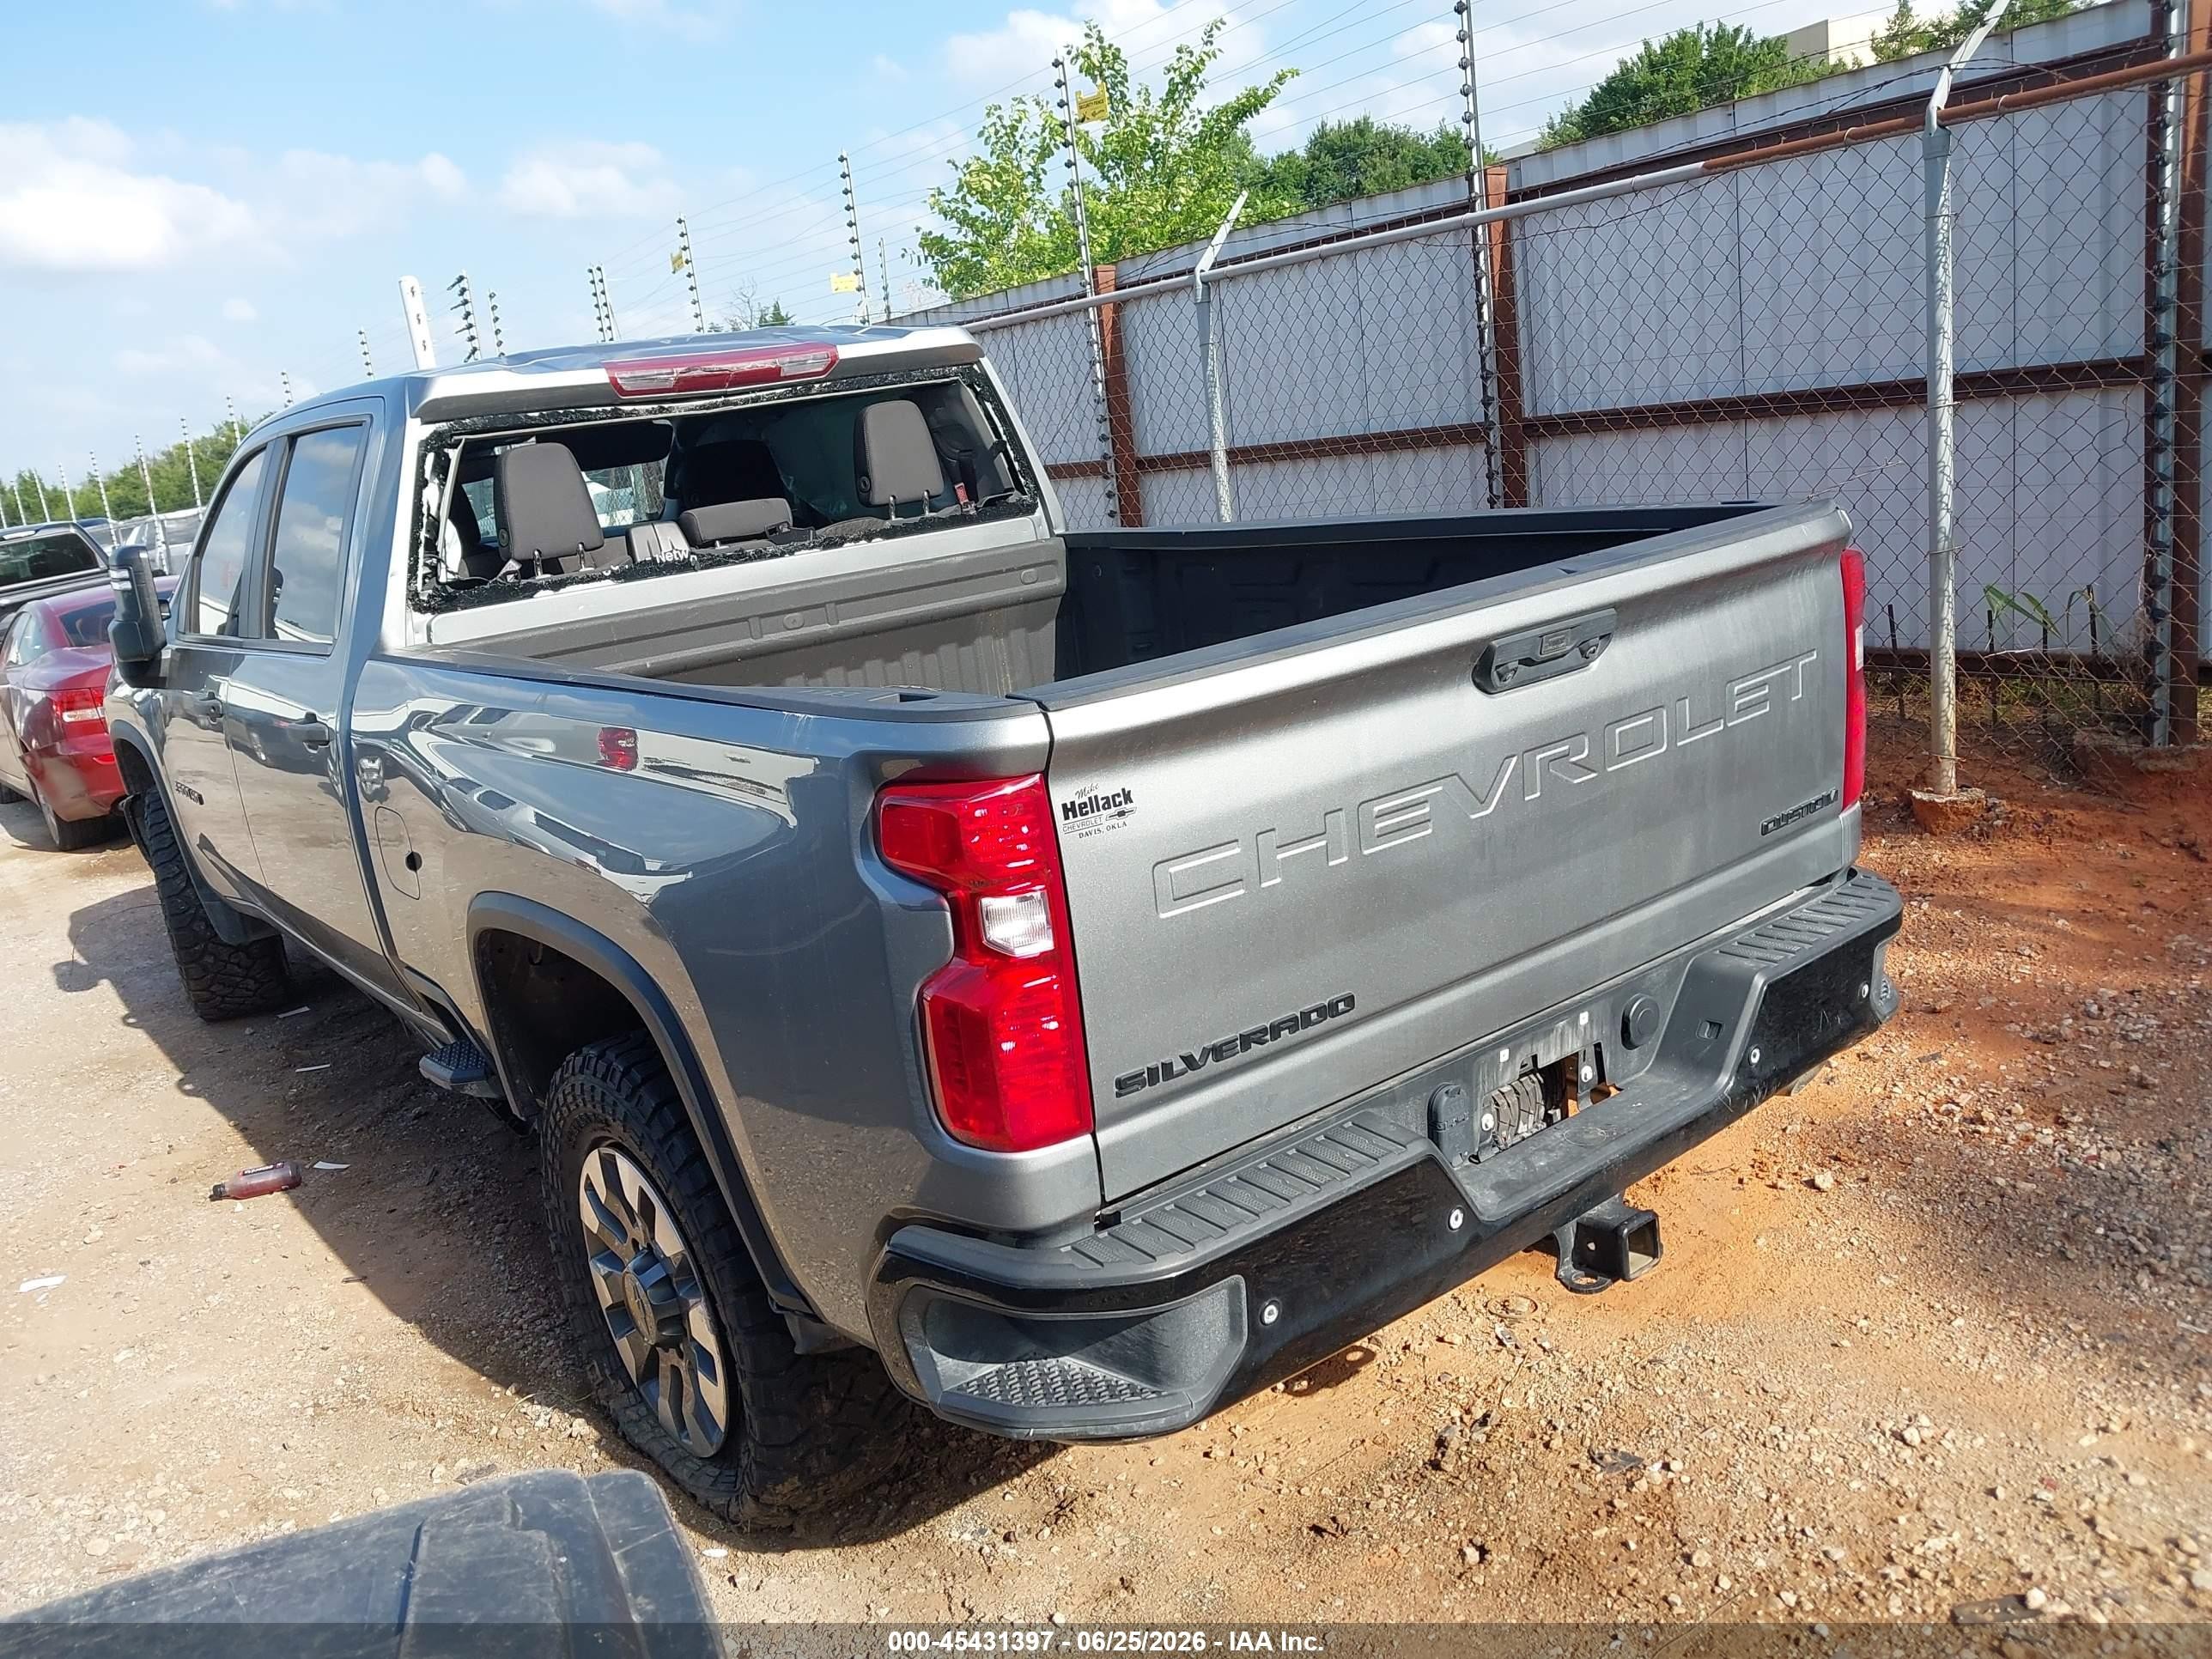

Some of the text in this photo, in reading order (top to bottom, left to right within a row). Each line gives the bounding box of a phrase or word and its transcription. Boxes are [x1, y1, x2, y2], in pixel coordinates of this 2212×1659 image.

[1061, 787, 1133, 821] Hellack
[1152, 650, 1817, 918] CHEVROLET
[1062, 817, 1103, 832] CHEVROLET
[1079, 821, 1127, 839] DAVIS, OKLA
[1760, 787, 1838, 836] CUSTOM
[1115, 993, 1356, 1098] SILVERADO
